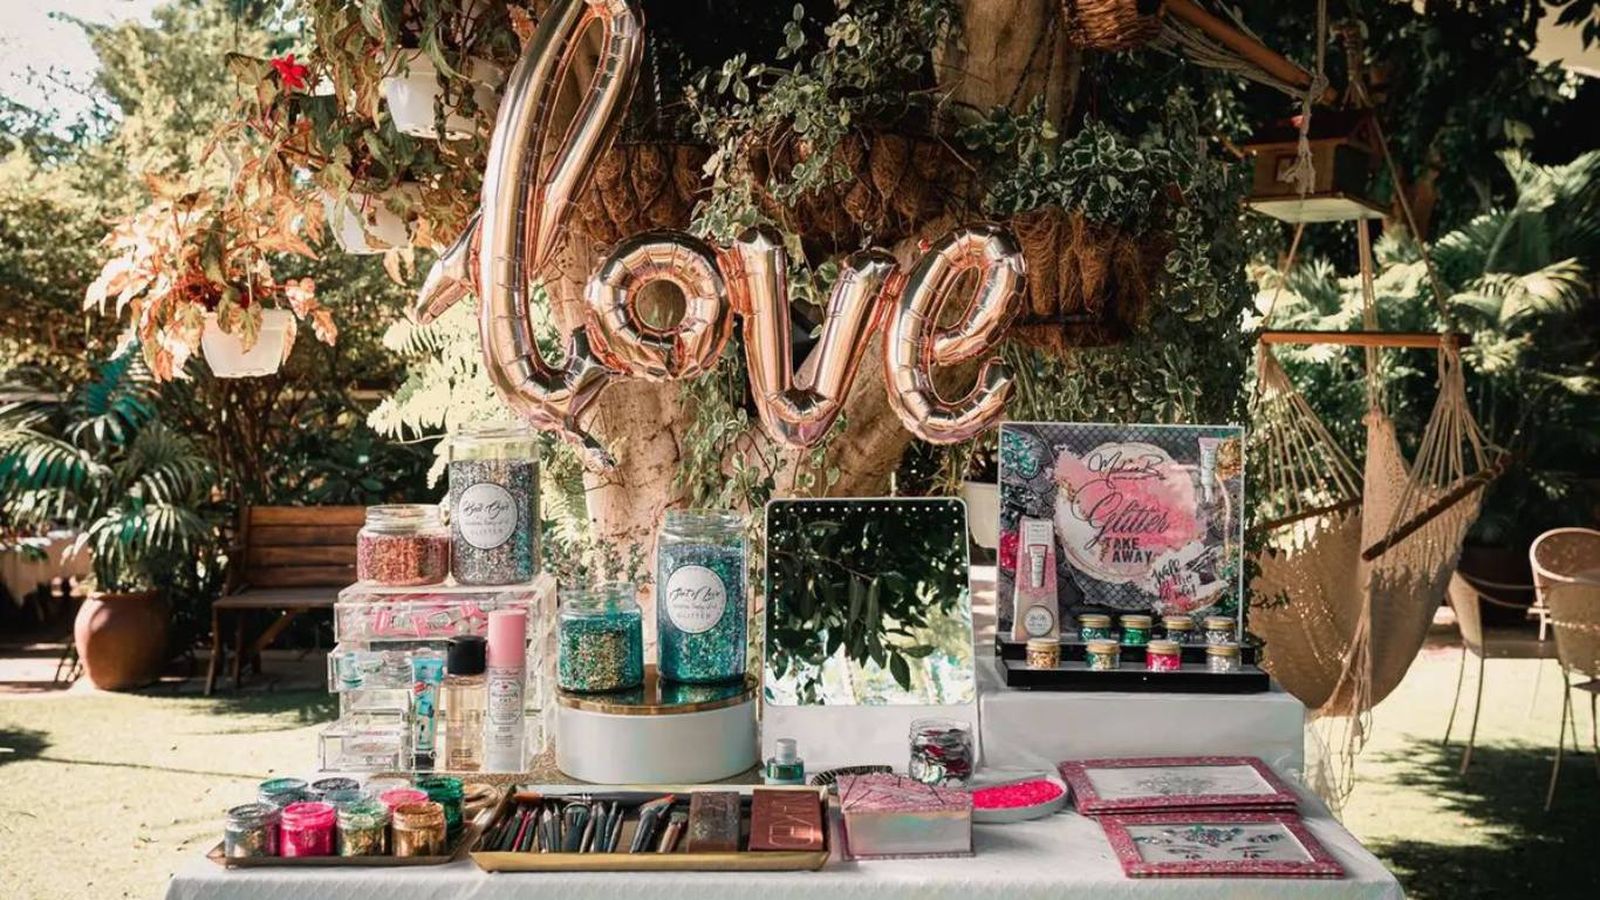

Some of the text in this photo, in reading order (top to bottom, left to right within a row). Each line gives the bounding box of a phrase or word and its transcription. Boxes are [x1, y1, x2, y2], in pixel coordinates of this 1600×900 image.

[417, 0, 1028, 472] love
[1071, 479, 1170, 550] Glitter
[1105, 537, 1140, 550] TAKE
[1112, 550, 1152, 564] AWAY
